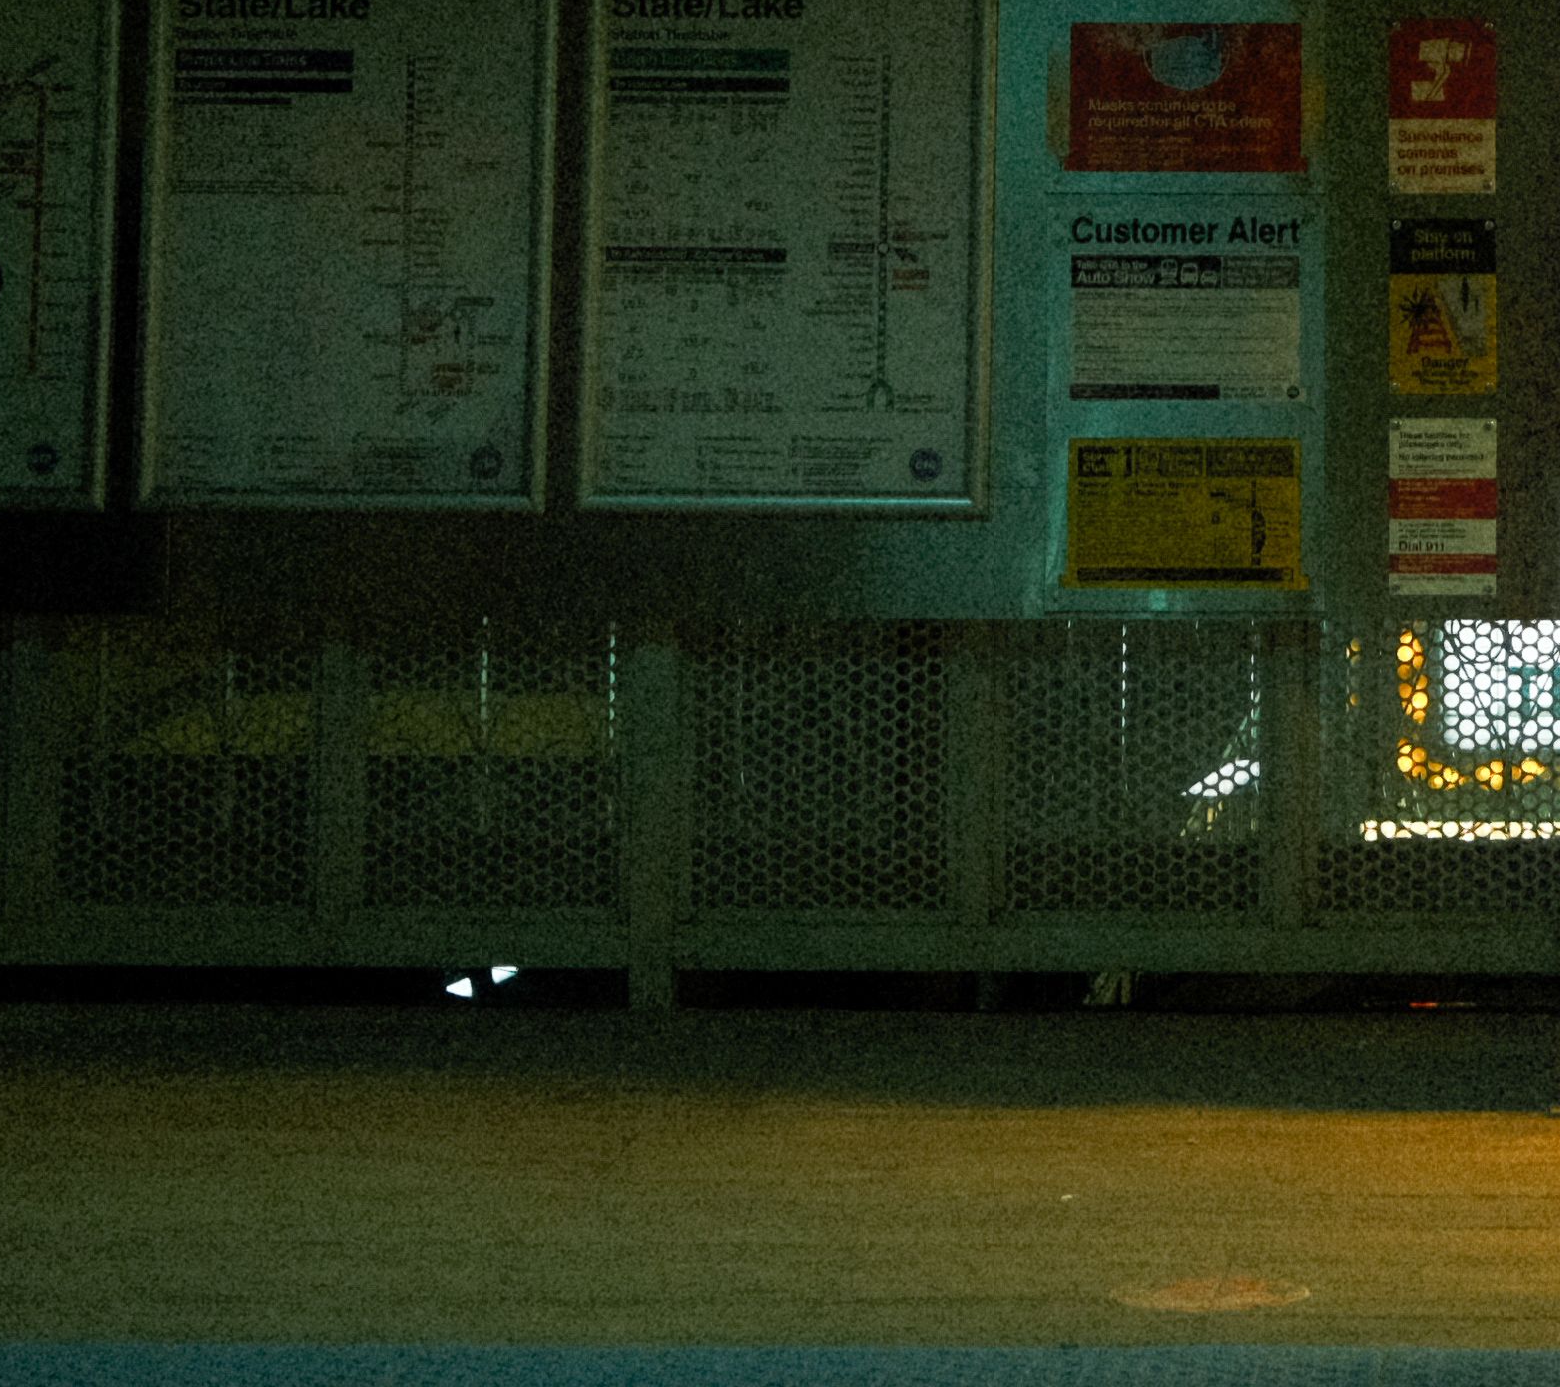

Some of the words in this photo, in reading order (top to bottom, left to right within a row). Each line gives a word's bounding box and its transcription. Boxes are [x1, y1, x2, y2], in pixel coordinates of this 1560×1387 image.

[1397, 129, 1484, 144] Surveillance
[1070, 216, 1219, 245] Customer
[1227, 215, 1301, 245] Alert
[1076, 270, 1112, 285] Auto
[1114, 270, 1157, 285] Show
[1398, 540, 1423, 552] Dial
[1425, 540, 1445, 552] 911
